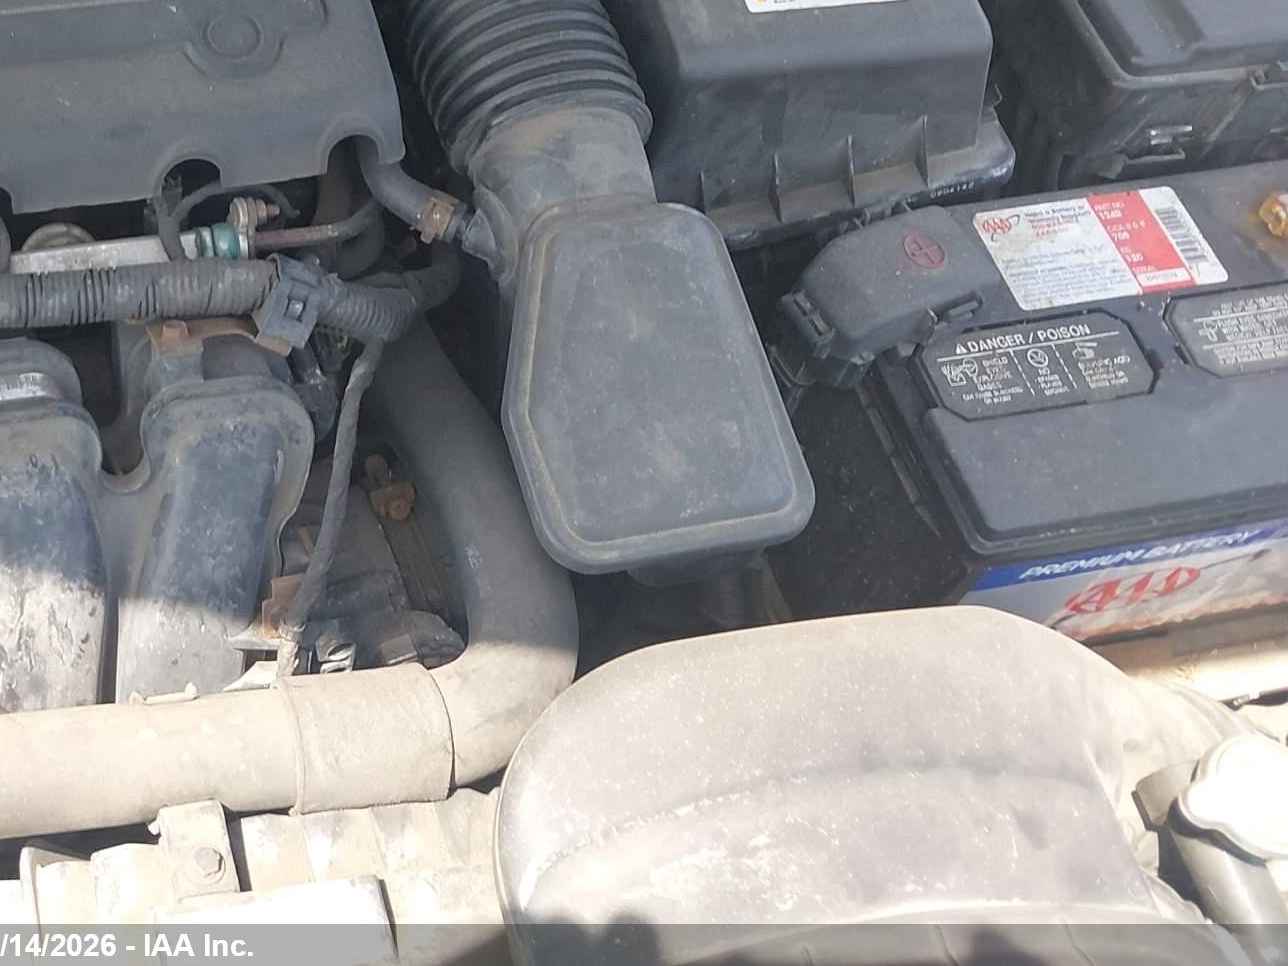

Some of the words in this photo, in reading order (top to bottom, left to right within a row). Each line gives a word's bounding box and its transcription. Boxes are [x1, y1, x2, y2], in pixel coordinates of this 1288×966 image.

[967, 334, 1026, 353] DANGER
[1037, 324, 1091, 342] POISON
[1018, 549, 1145, 580] PREMIUM
[1143, 529, 1262, 560] BATTERY
